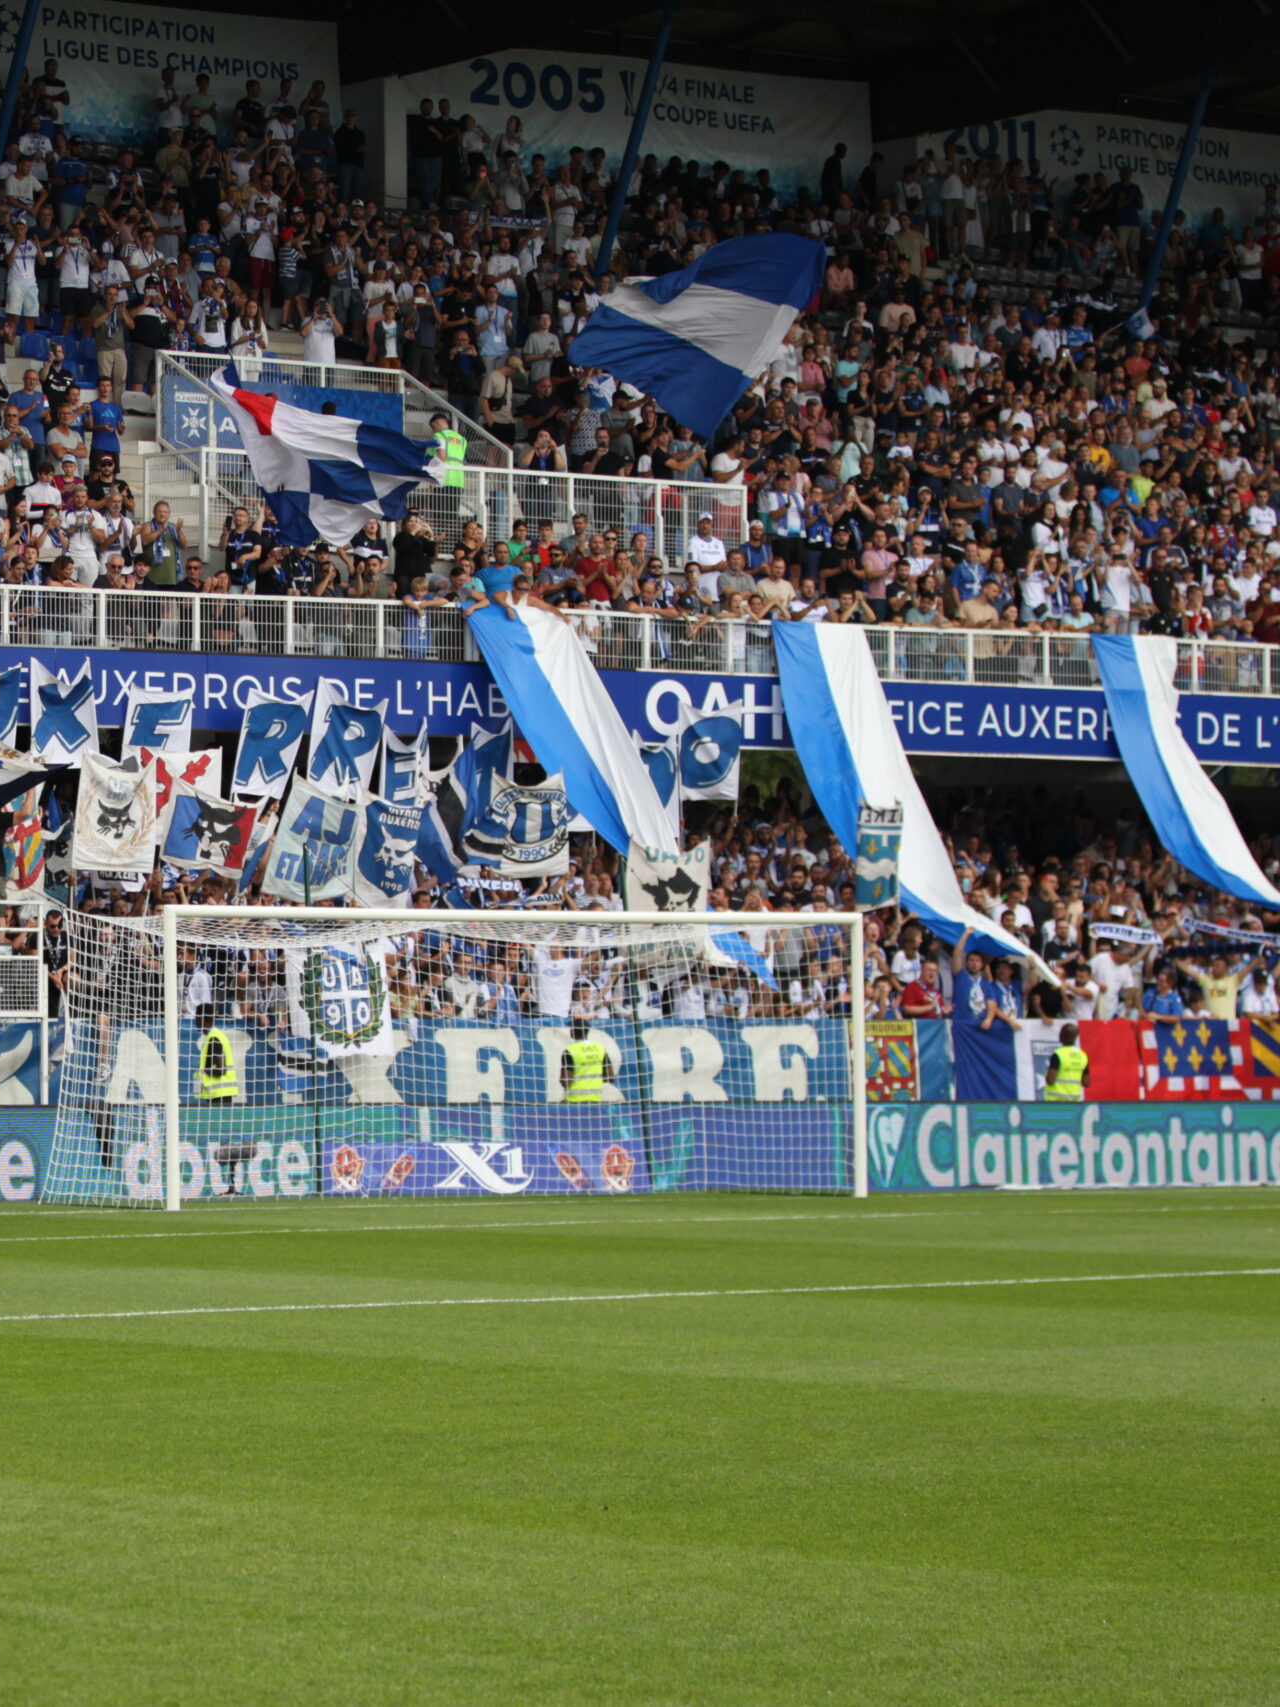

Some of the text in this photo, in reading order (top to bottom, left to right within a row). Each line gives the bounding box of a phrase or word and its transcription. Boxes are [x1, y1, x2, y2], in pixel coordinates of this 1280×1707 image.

[42, 8, 215, 45] PARTICIPATION
[43, 38, 299, 81] LIGUE DES CHAMPIONS
[470, 58, 606, 113] 2005
[685, 79, 755, 104] FINALE
[654, 103, 776, 135] COUPE UEFA
[1096, 124, 1230, 159] PARTICIPAION
[1098, 153, 1149, 174] LIGUE
[1156, 161, 1178, 178] DE
[1196, 711, 1241, 748] DE
[289, 795, 357, 845] AJ
[518, 846, 547, 860] 1990
